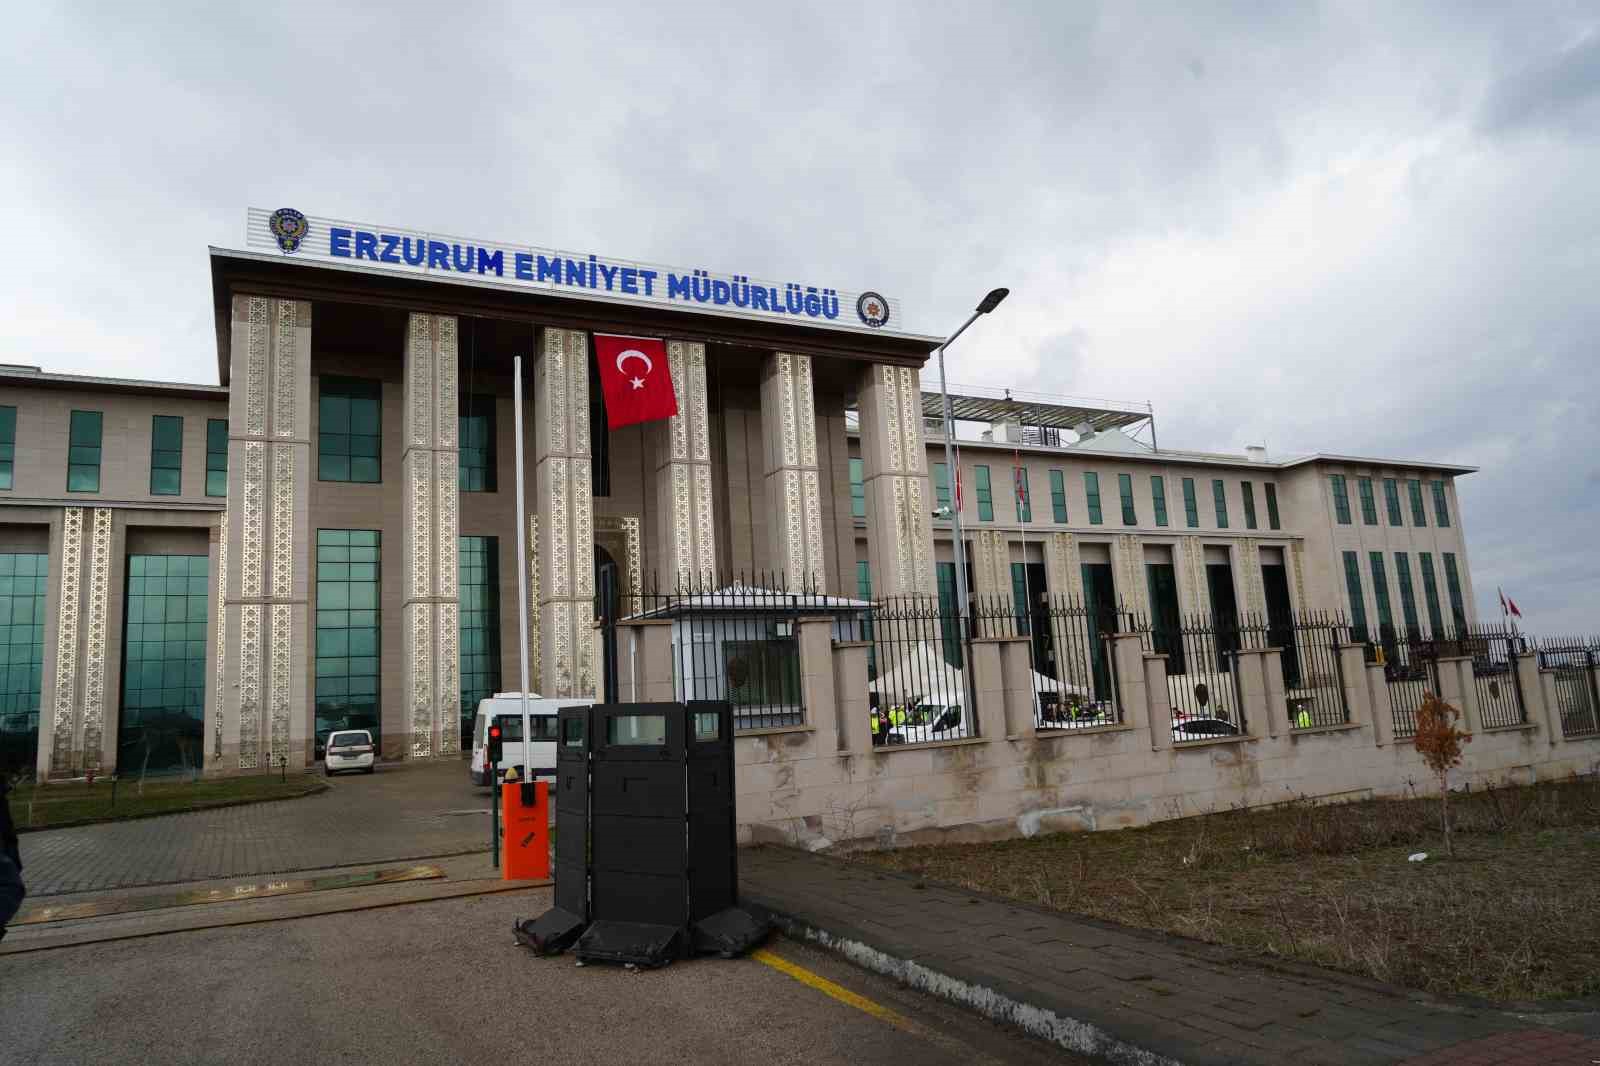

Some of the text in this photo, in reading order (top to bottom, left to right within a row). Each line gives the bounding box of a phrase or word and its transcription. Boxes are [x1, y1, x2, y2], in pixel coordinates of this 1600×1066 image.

[330, 227, 504, 277] ERZURUM
[515, 253, 657, 297] EMNİYET
[667, 270, 839, 320] MÜDÜRLÜĞÜ
